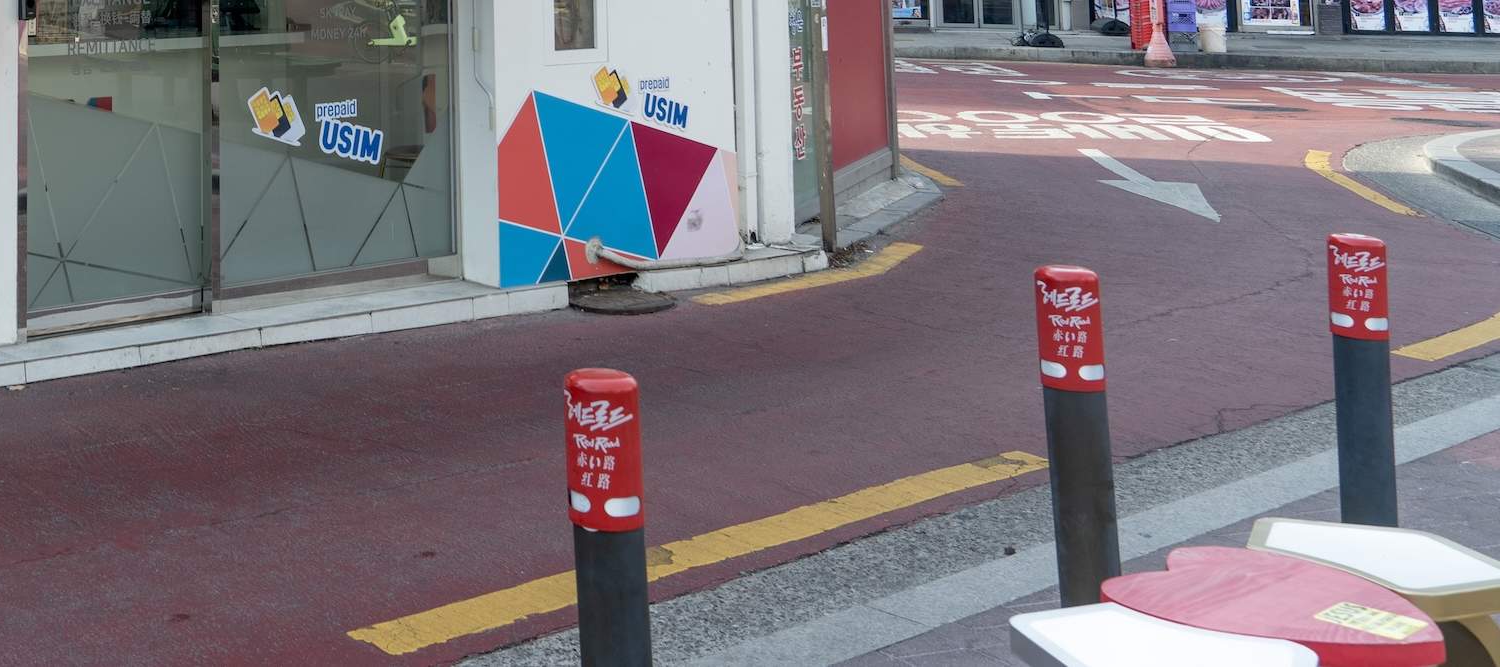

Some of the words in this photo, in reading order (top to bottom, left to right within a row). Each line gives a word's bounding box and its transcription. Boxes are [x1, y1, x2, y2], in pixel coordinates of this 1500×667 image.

[640, 76, 670, 90] prepaid
[316, 100, 357, 119] prepaid
[644, 93, 689, 129] USIM
[791, 46, 806, 161] 부동산
[321, 120, 382, 162] USIM
